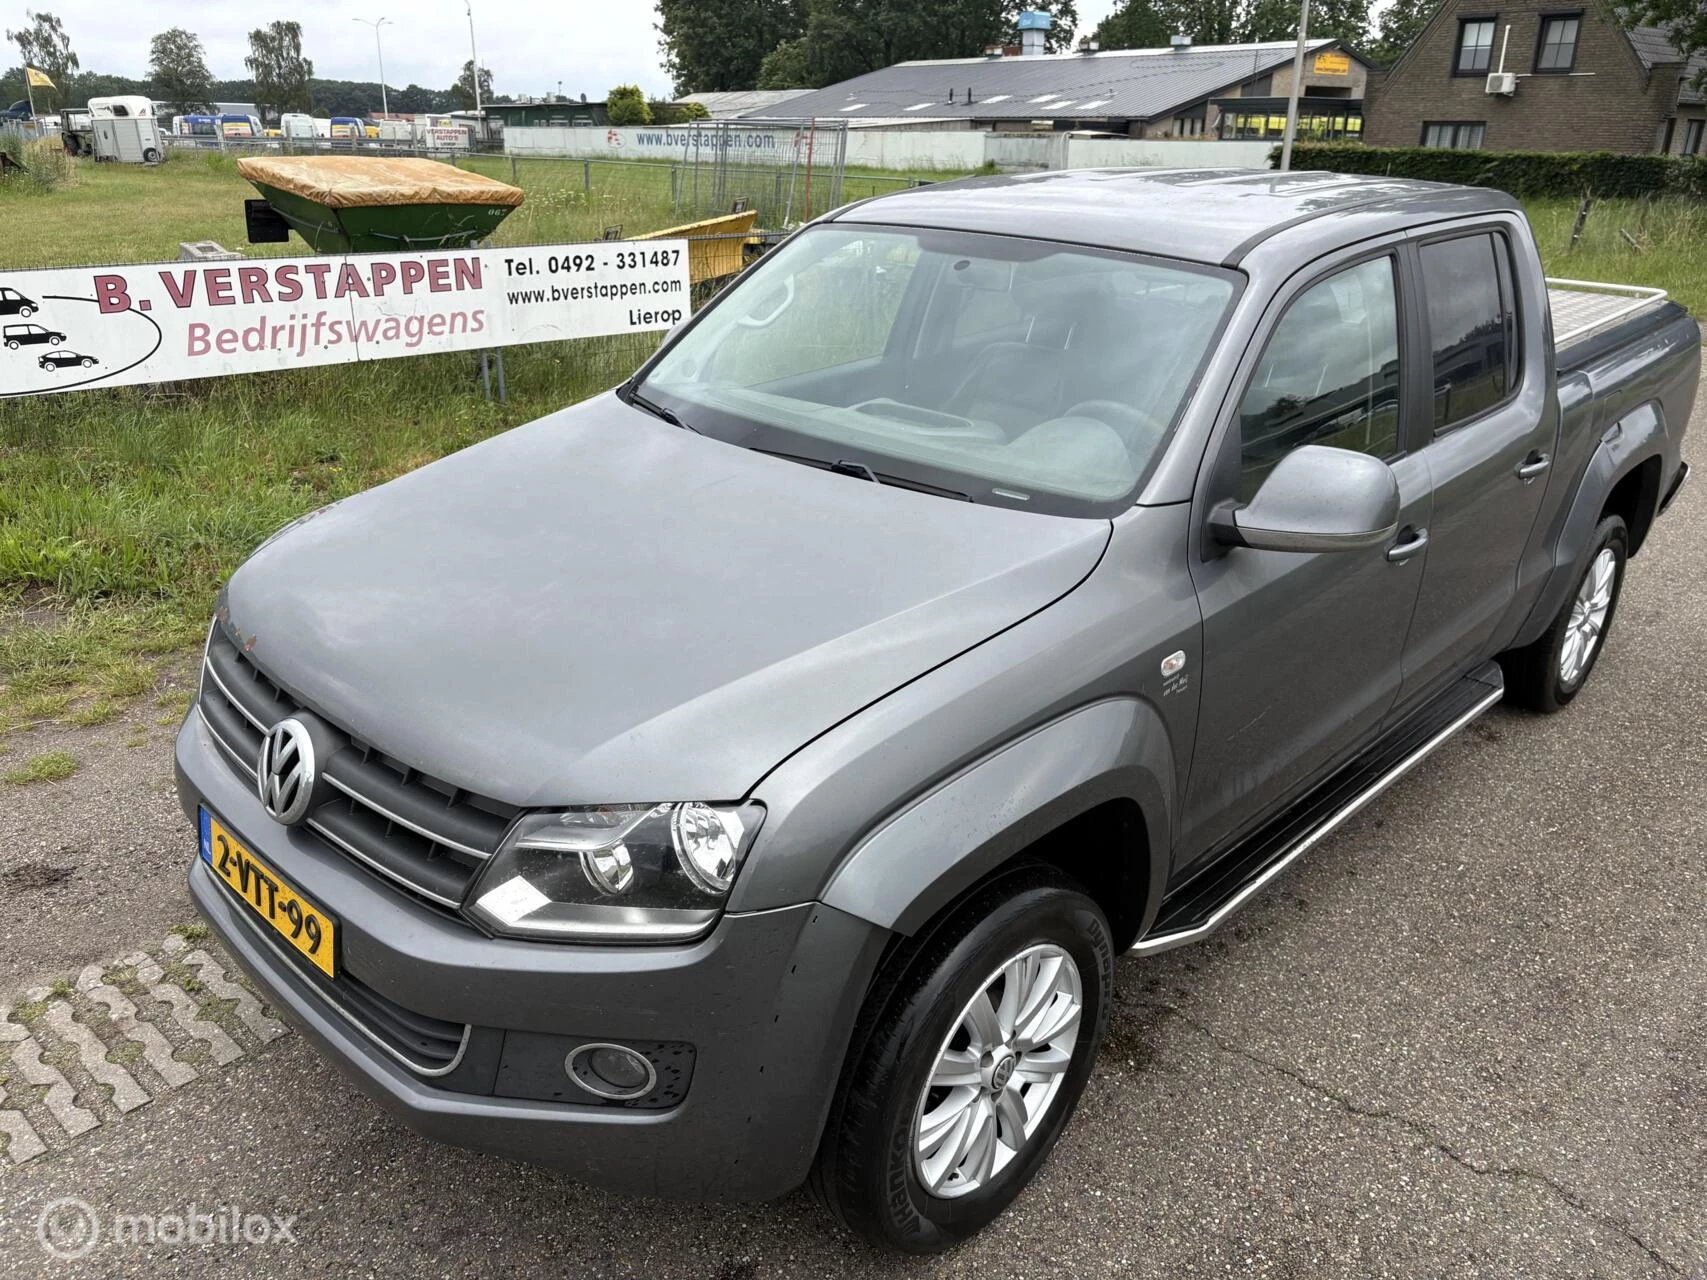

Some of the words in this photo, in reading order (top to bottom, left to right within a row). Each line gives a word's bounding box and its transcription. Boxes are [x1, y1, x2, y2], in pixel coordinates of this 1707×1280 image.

[636, 129, 775, 151] www.bverstappen.com
[504, 258, 540, 276] Tel.
[548, 255, 595, 274] 0492
[616, 250, 680, 269] 331487
[93, 274, 152, 314] B.
[158, 257, 483, 308] VERSTAPPEN
[507, 279, 682, 305] www.bverstappen.com
[629, 309, 682, 326] Lierop
[187, 308, 485, 358] Bedrijfswagens
[217, 834, 322, 955] 2-VTT-99
